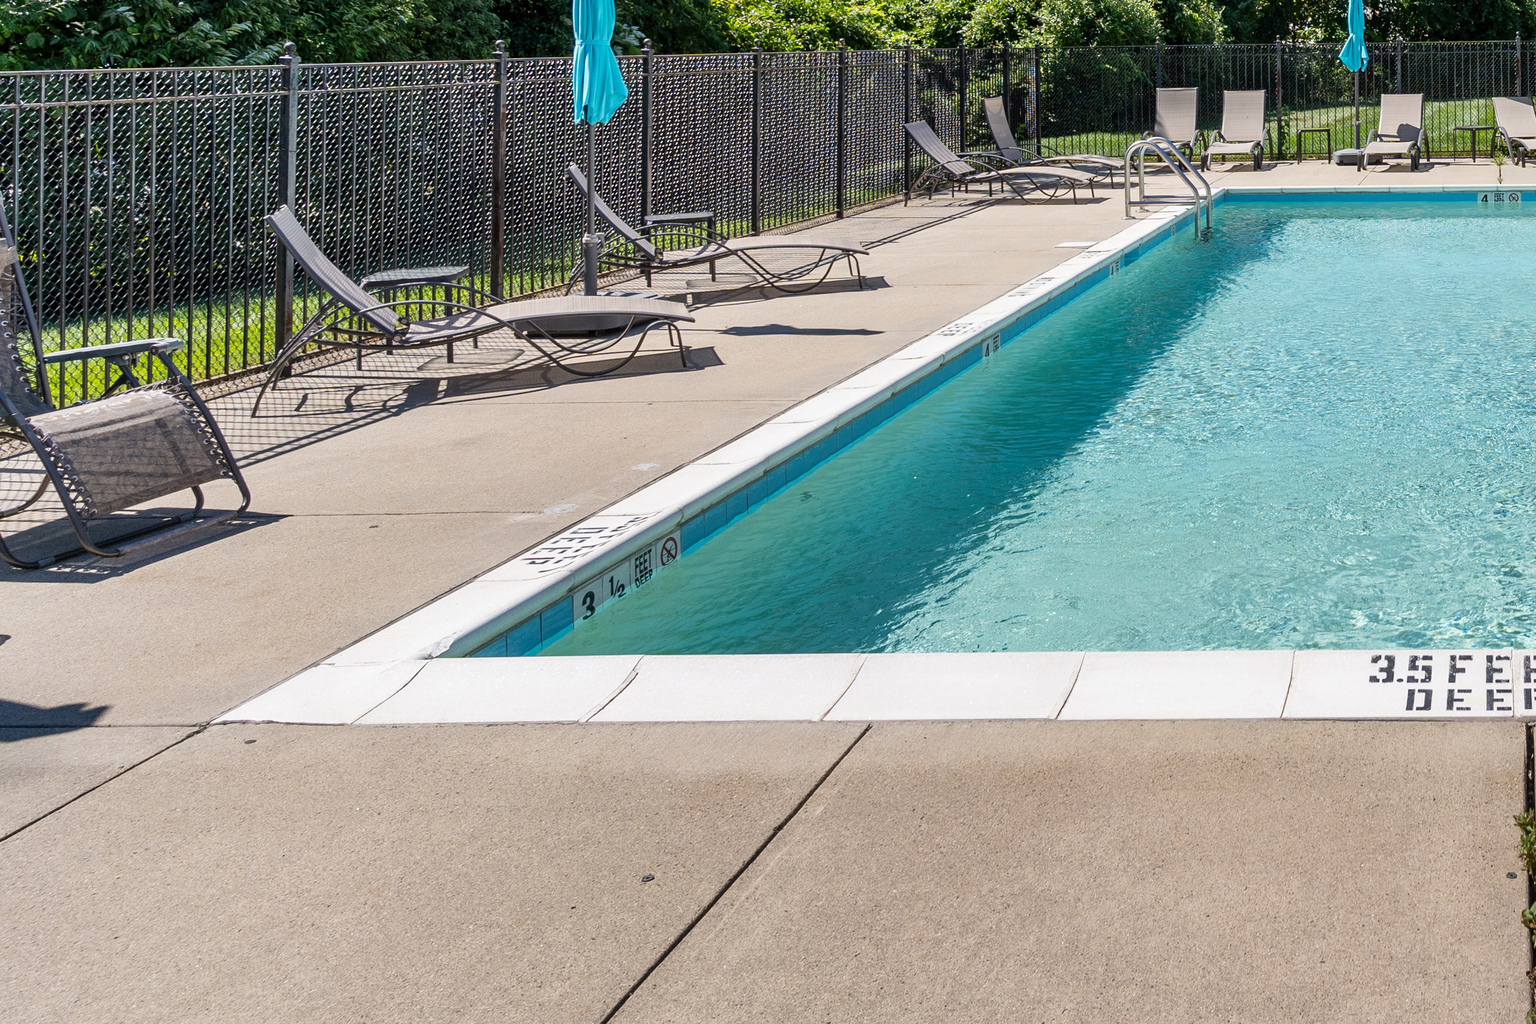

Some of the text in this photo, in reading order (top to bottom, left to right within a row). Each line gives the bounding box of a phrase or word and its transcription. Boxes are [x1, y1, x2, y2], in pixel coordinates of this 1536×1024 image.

[1481, 194, 1488, 202] 4
[521, 527, 609, 565] DEEP
[634, 548, 652, 578] FEET
[635, 568, 653, 588] DEEP
[582, 590, 596, 621] 3
